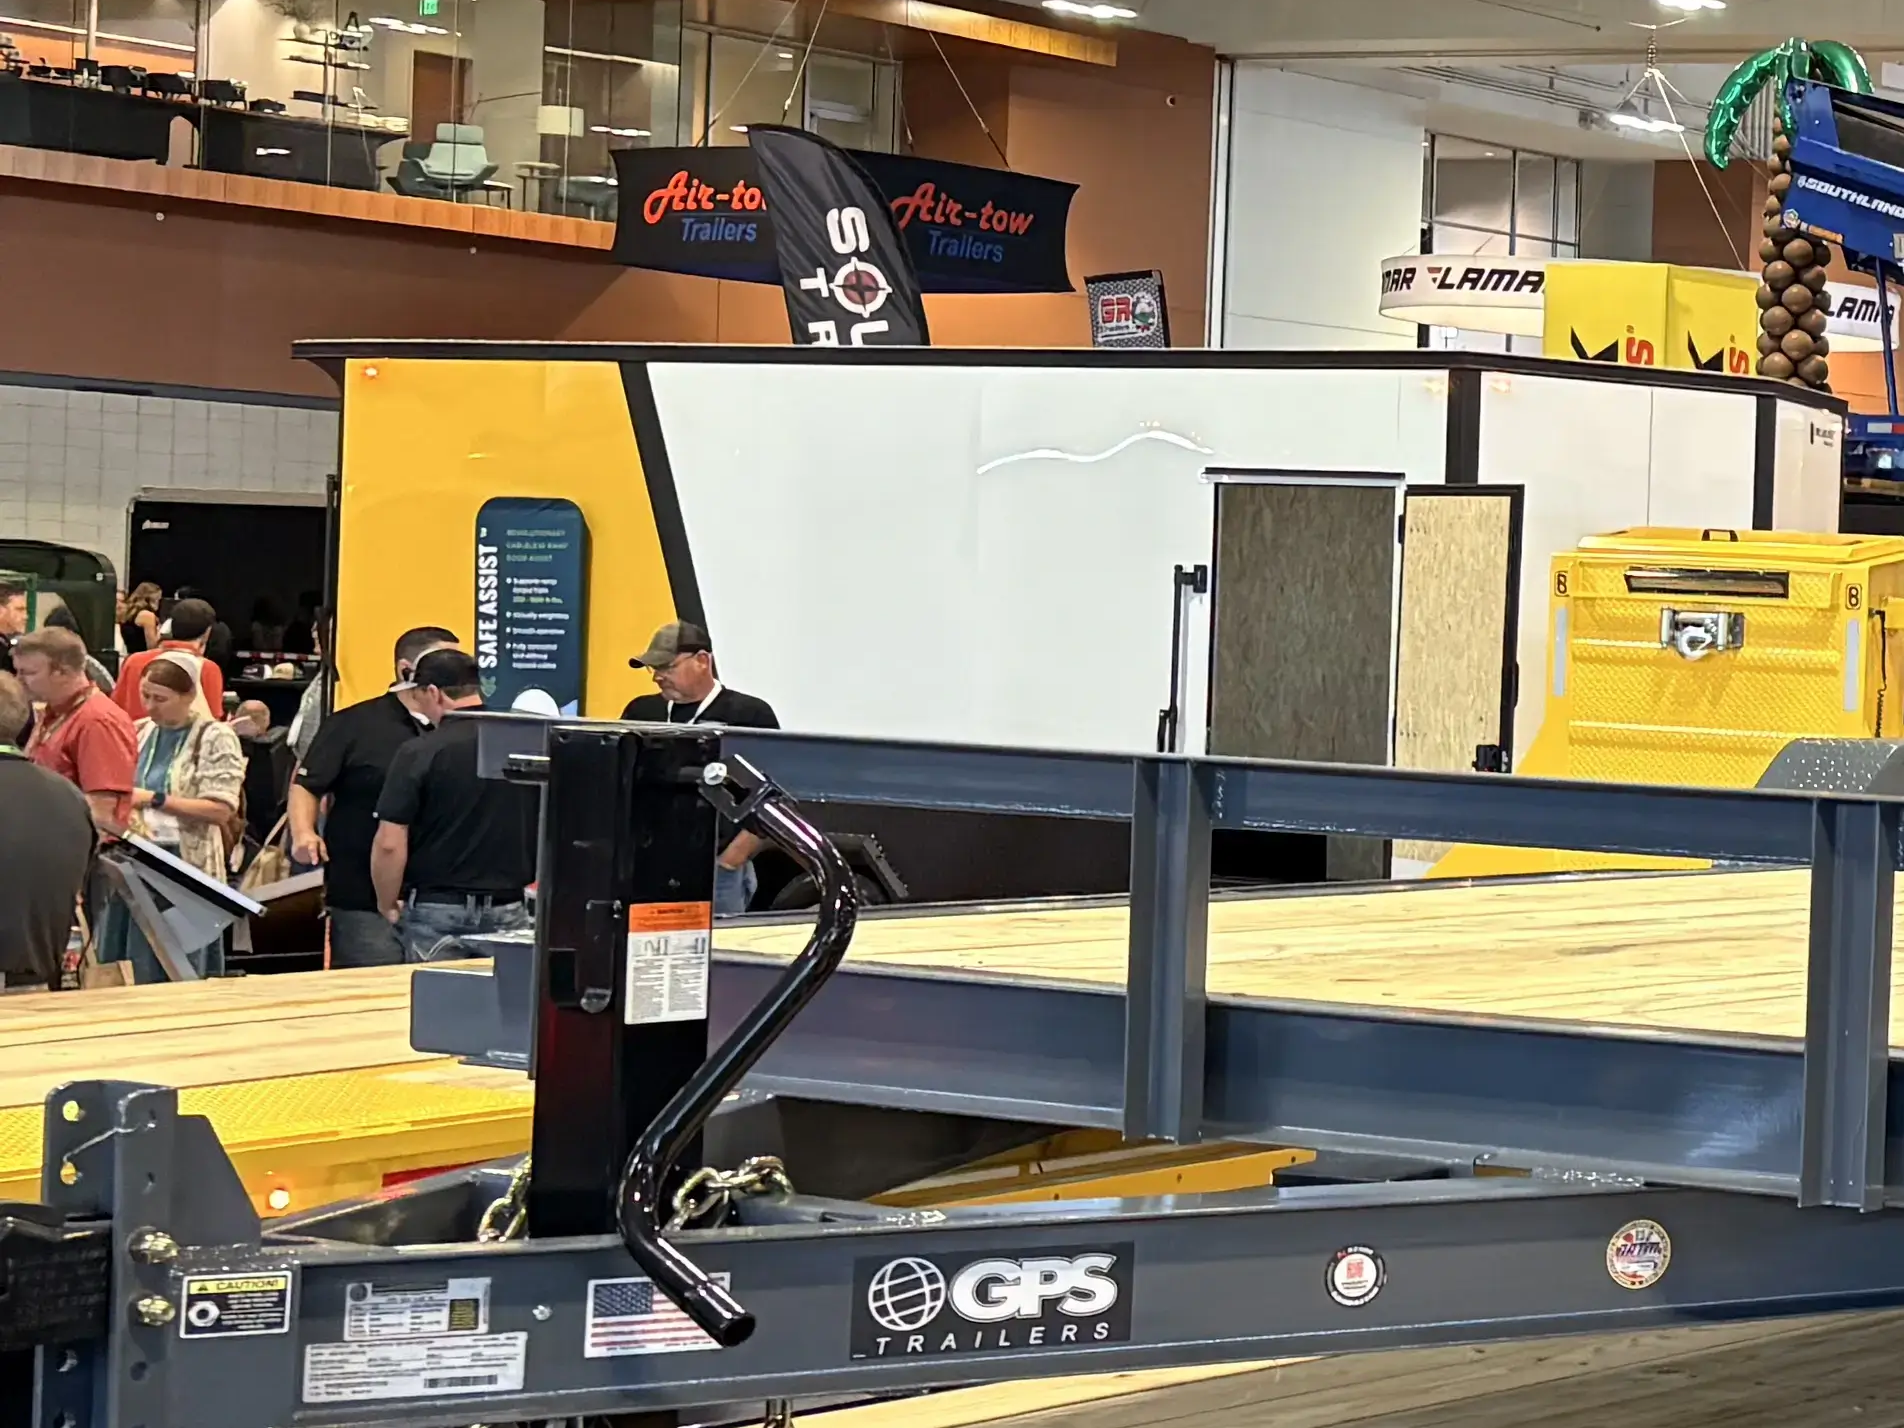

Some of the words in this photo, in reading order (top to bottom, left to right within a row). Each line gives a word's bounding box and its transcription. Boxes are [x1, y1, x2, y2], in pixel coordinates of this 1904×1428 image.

[681, 217, 757, 242] Trailers
[891, 182, 1034, 236] Air-tow
[928, 230, 1004, 264] Trailers
[478, 544, 498, 615] ASSIST
[478, 619, 498, 669] SAFE
[216, 1279, 279, 1291] CAUTION!
[949, 1252, 1118, 1324] GPS
[876, 1322, 1110, 1356] TRAILERS
